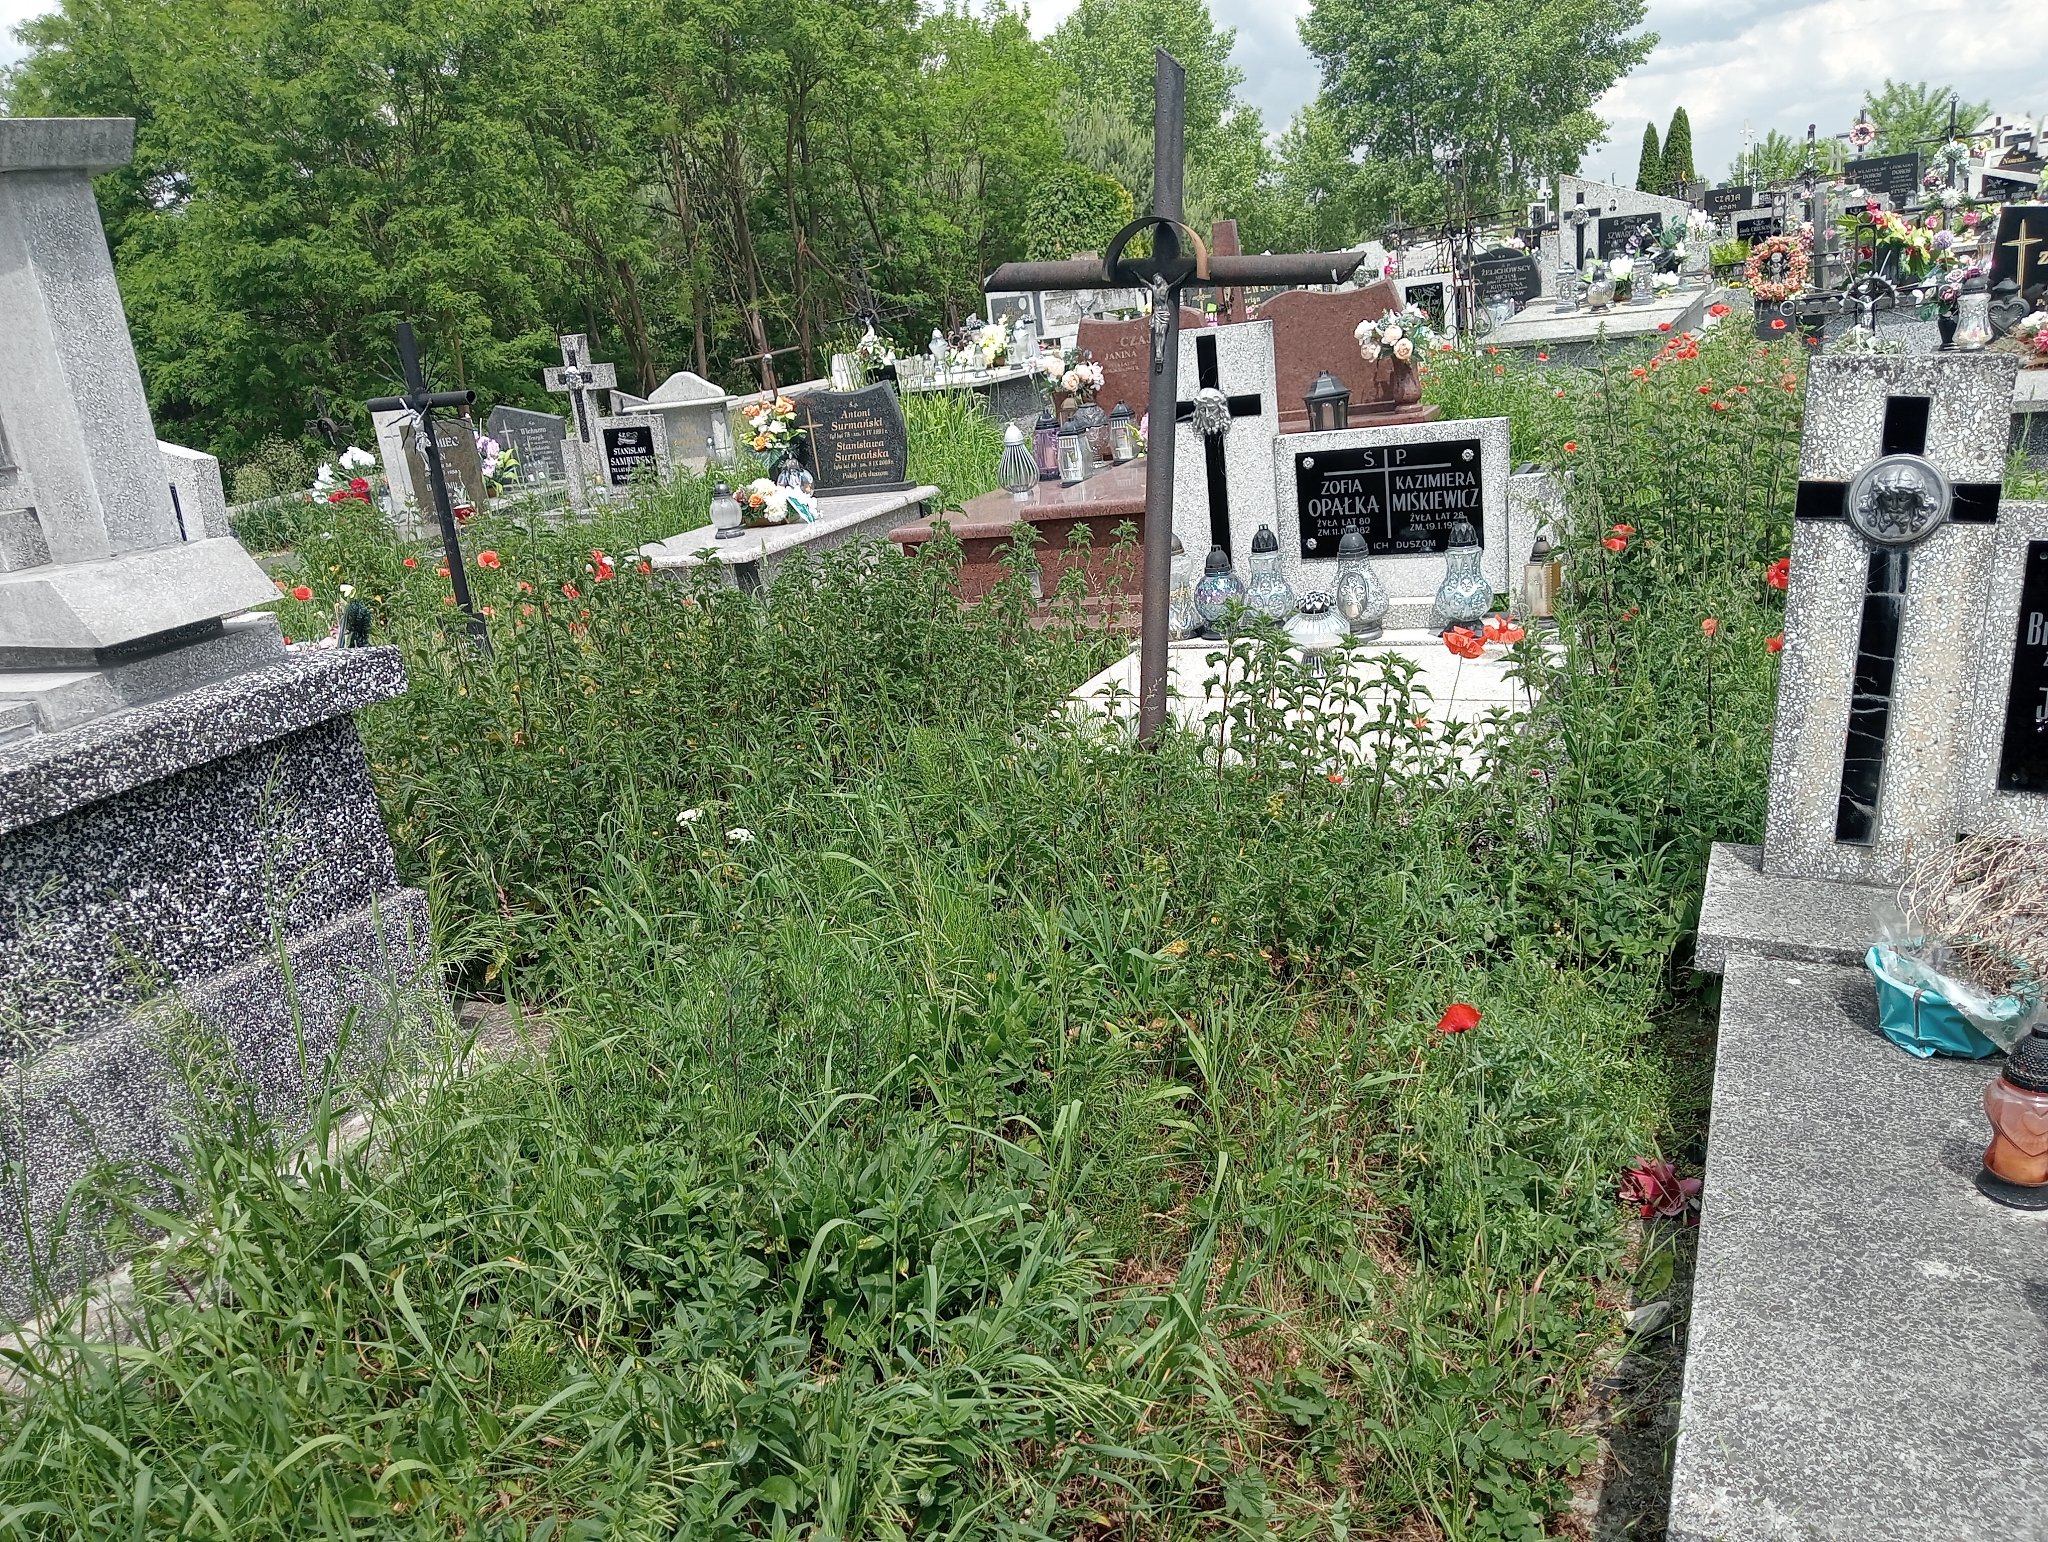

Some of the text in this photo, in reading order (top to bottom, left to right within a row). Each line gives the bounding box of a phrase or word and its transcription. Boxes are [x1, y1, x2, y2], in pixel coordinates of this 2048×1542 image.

[1104, 350, 1138, 361] JANINA
[840, 408, 871, 419] Antoni
[831, 417, 883, 431] Surmański
[836, 439, 885, 451] Stanisława
[834, 449, 890, 462] Surmańska
[1321, 478, 1363, 496] ZOFIA
[1396, 471, 1476, 491] KAZIMIERA
[1392, 488, 1479, 512] MIŚKIEWICZ
[1308, 495, 1380, 518] OPAŁKA
[1341, 517, 1357, 526] LAT
[1359, 517, 1371, 526] 80
[1435, 512, 1451, 521] LAT
[1373, 539, 1437, 550] ICH DUSZOM
